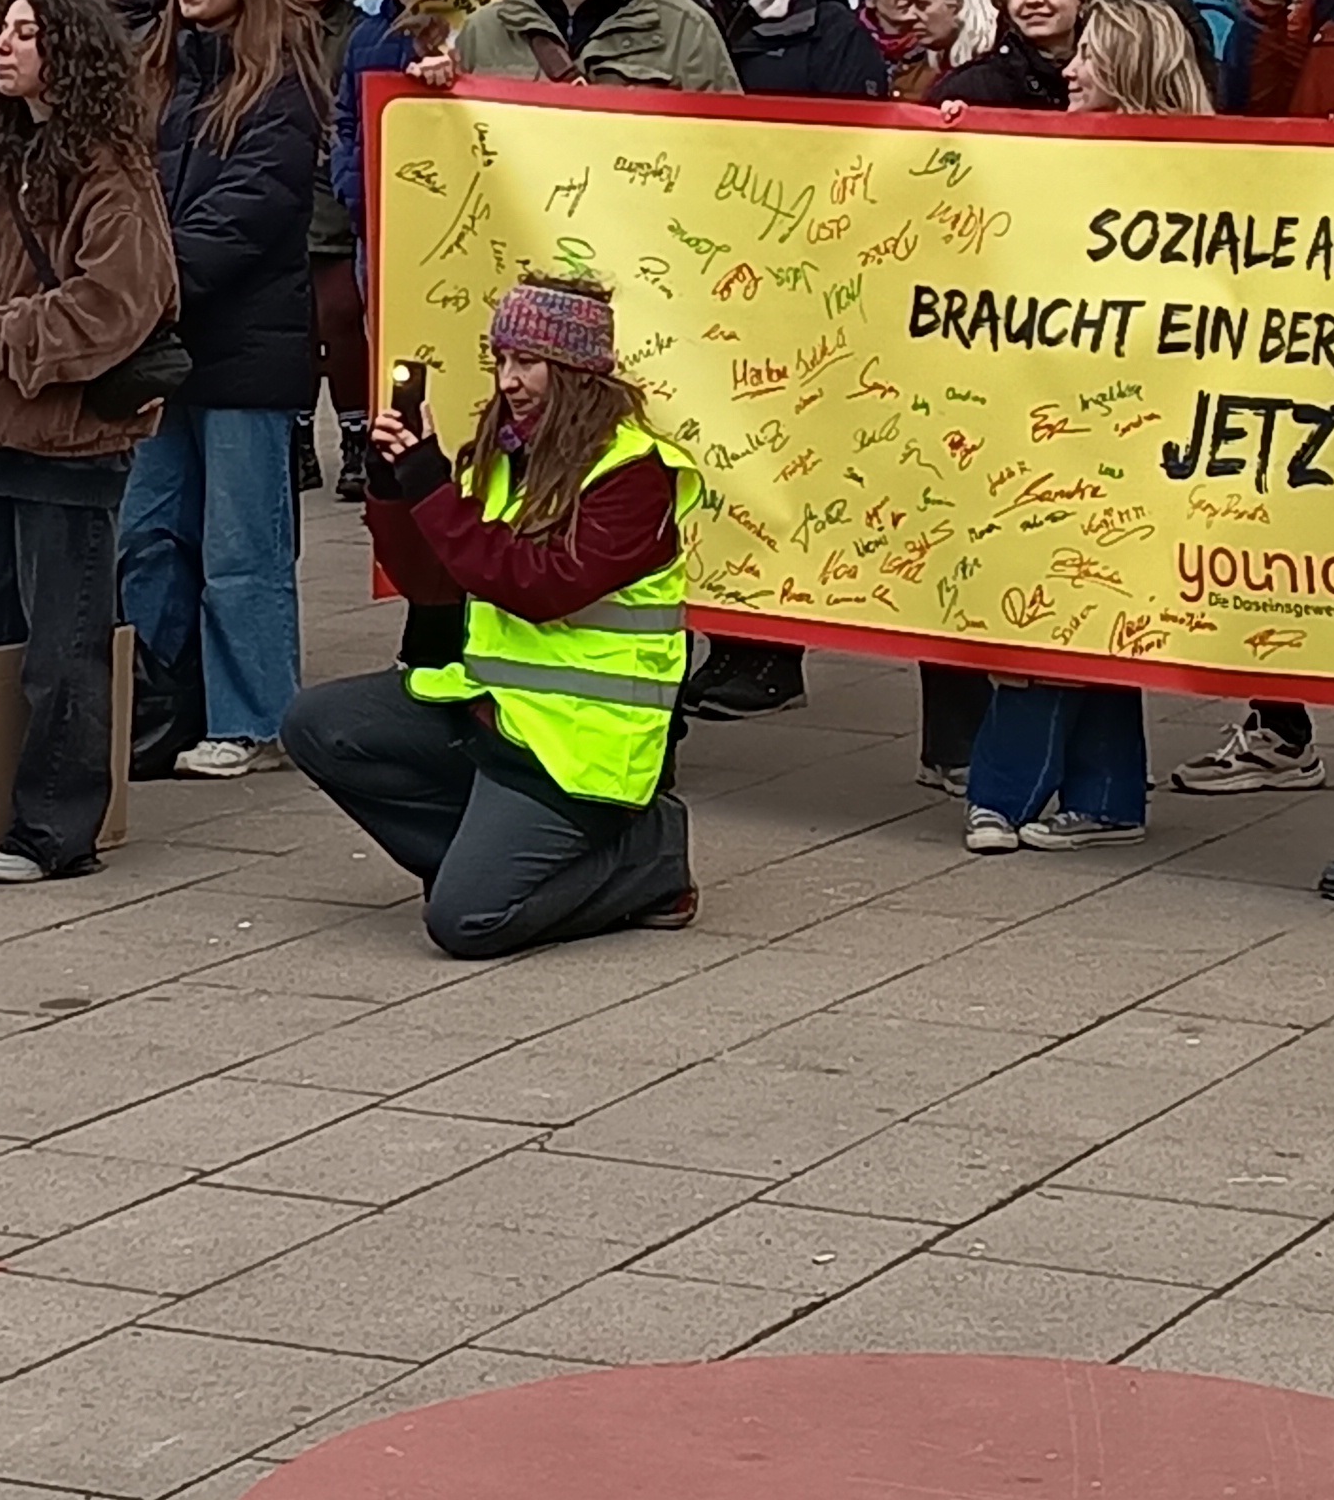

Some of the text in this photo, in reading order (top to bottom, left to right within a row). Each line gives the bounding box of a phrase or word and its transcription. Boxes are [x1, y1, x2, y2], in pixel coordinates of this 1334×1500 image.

[1086, 207, 1299, 275] SOZIALE
[907, 284, 1146, 357] BRAUCHT
[1157, 301, 1249, 361] EIN
[1208, 590, 1231, 607] Die
